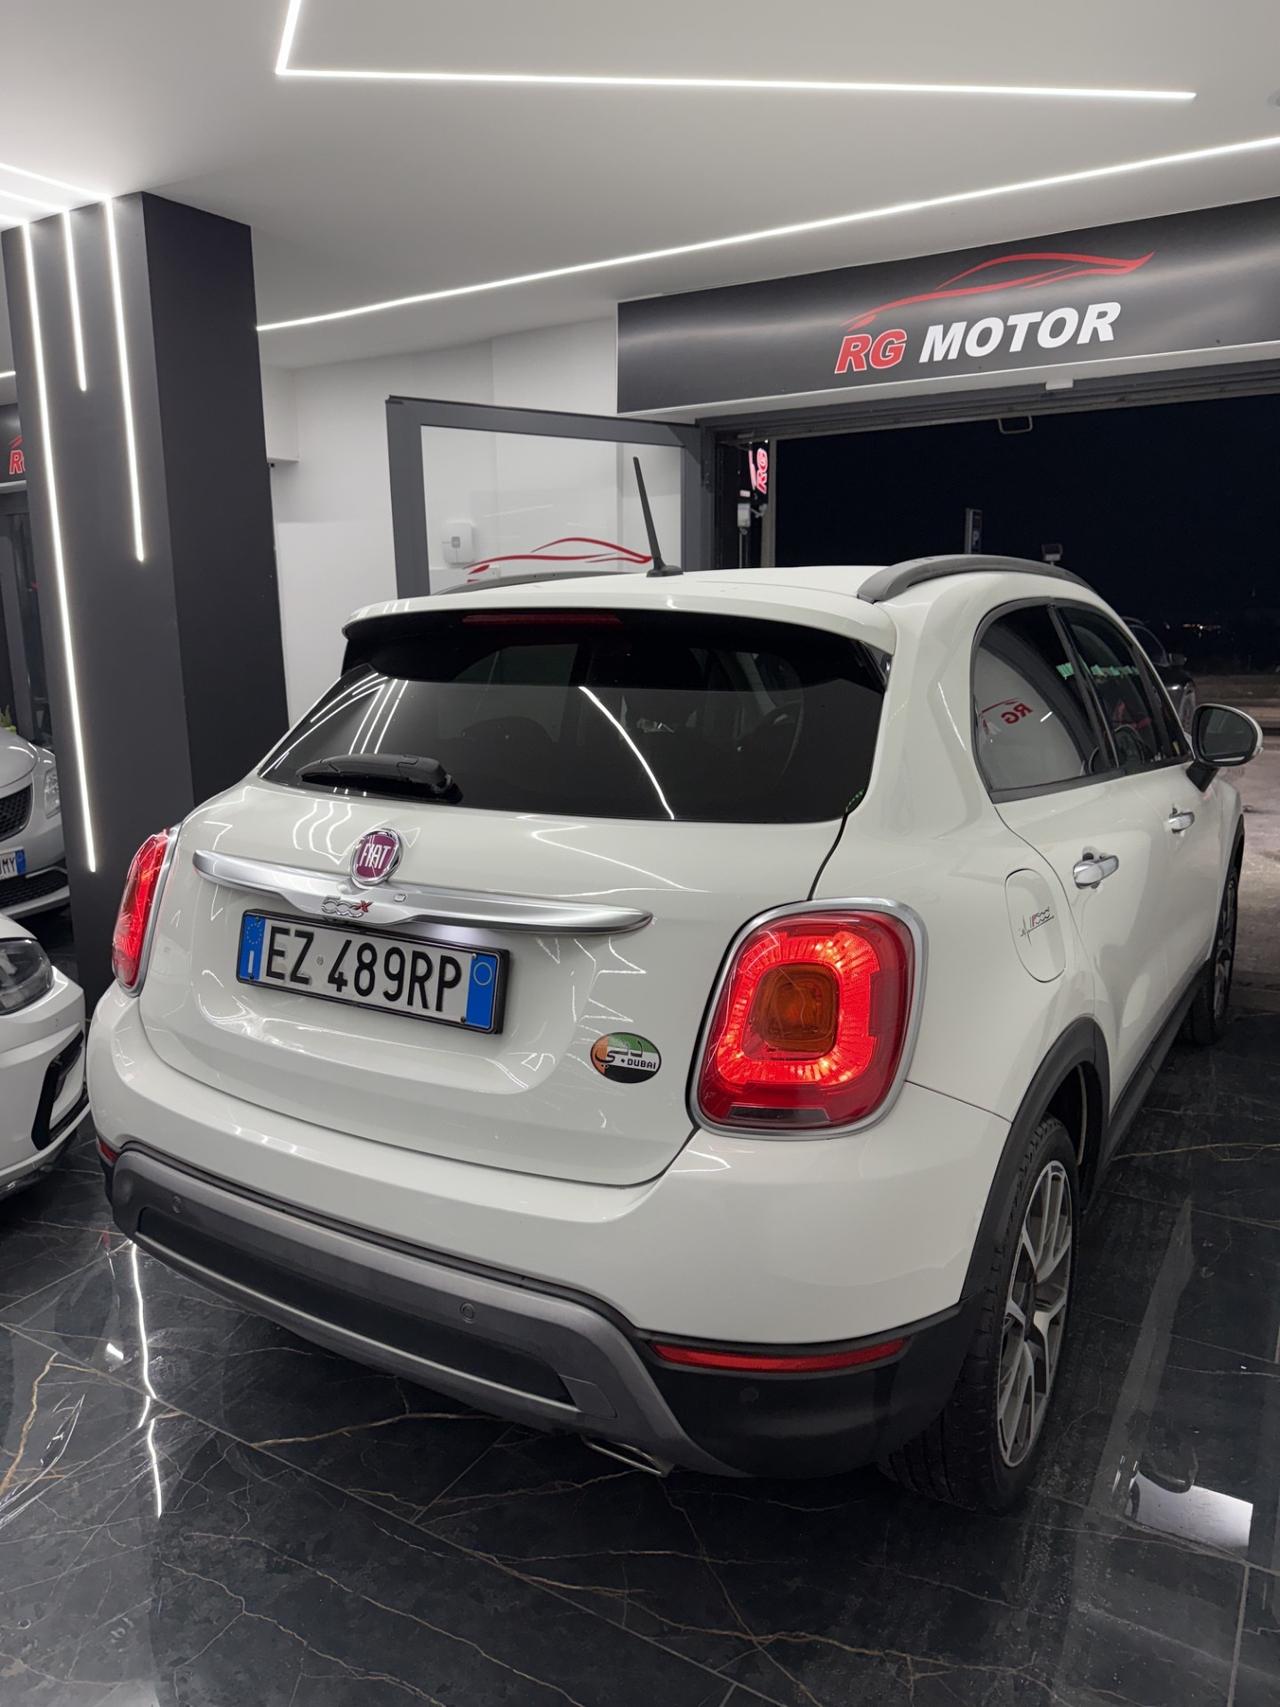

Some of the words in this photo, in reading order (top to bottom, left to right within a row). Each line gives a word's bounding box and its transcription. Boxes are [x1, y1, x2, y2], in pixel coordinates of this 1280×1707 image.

[834, 329, 907, 374] RG
[919, 301, 1121, 363] MOTOR
[9, 449, 26, 475] R
[359, 842, 391, 869] FIAT
[266, 926, 315, 985] EZ
[328, 939, 462, 1012] 489RP
[626, 1058, 657, 1070] DUBAI
